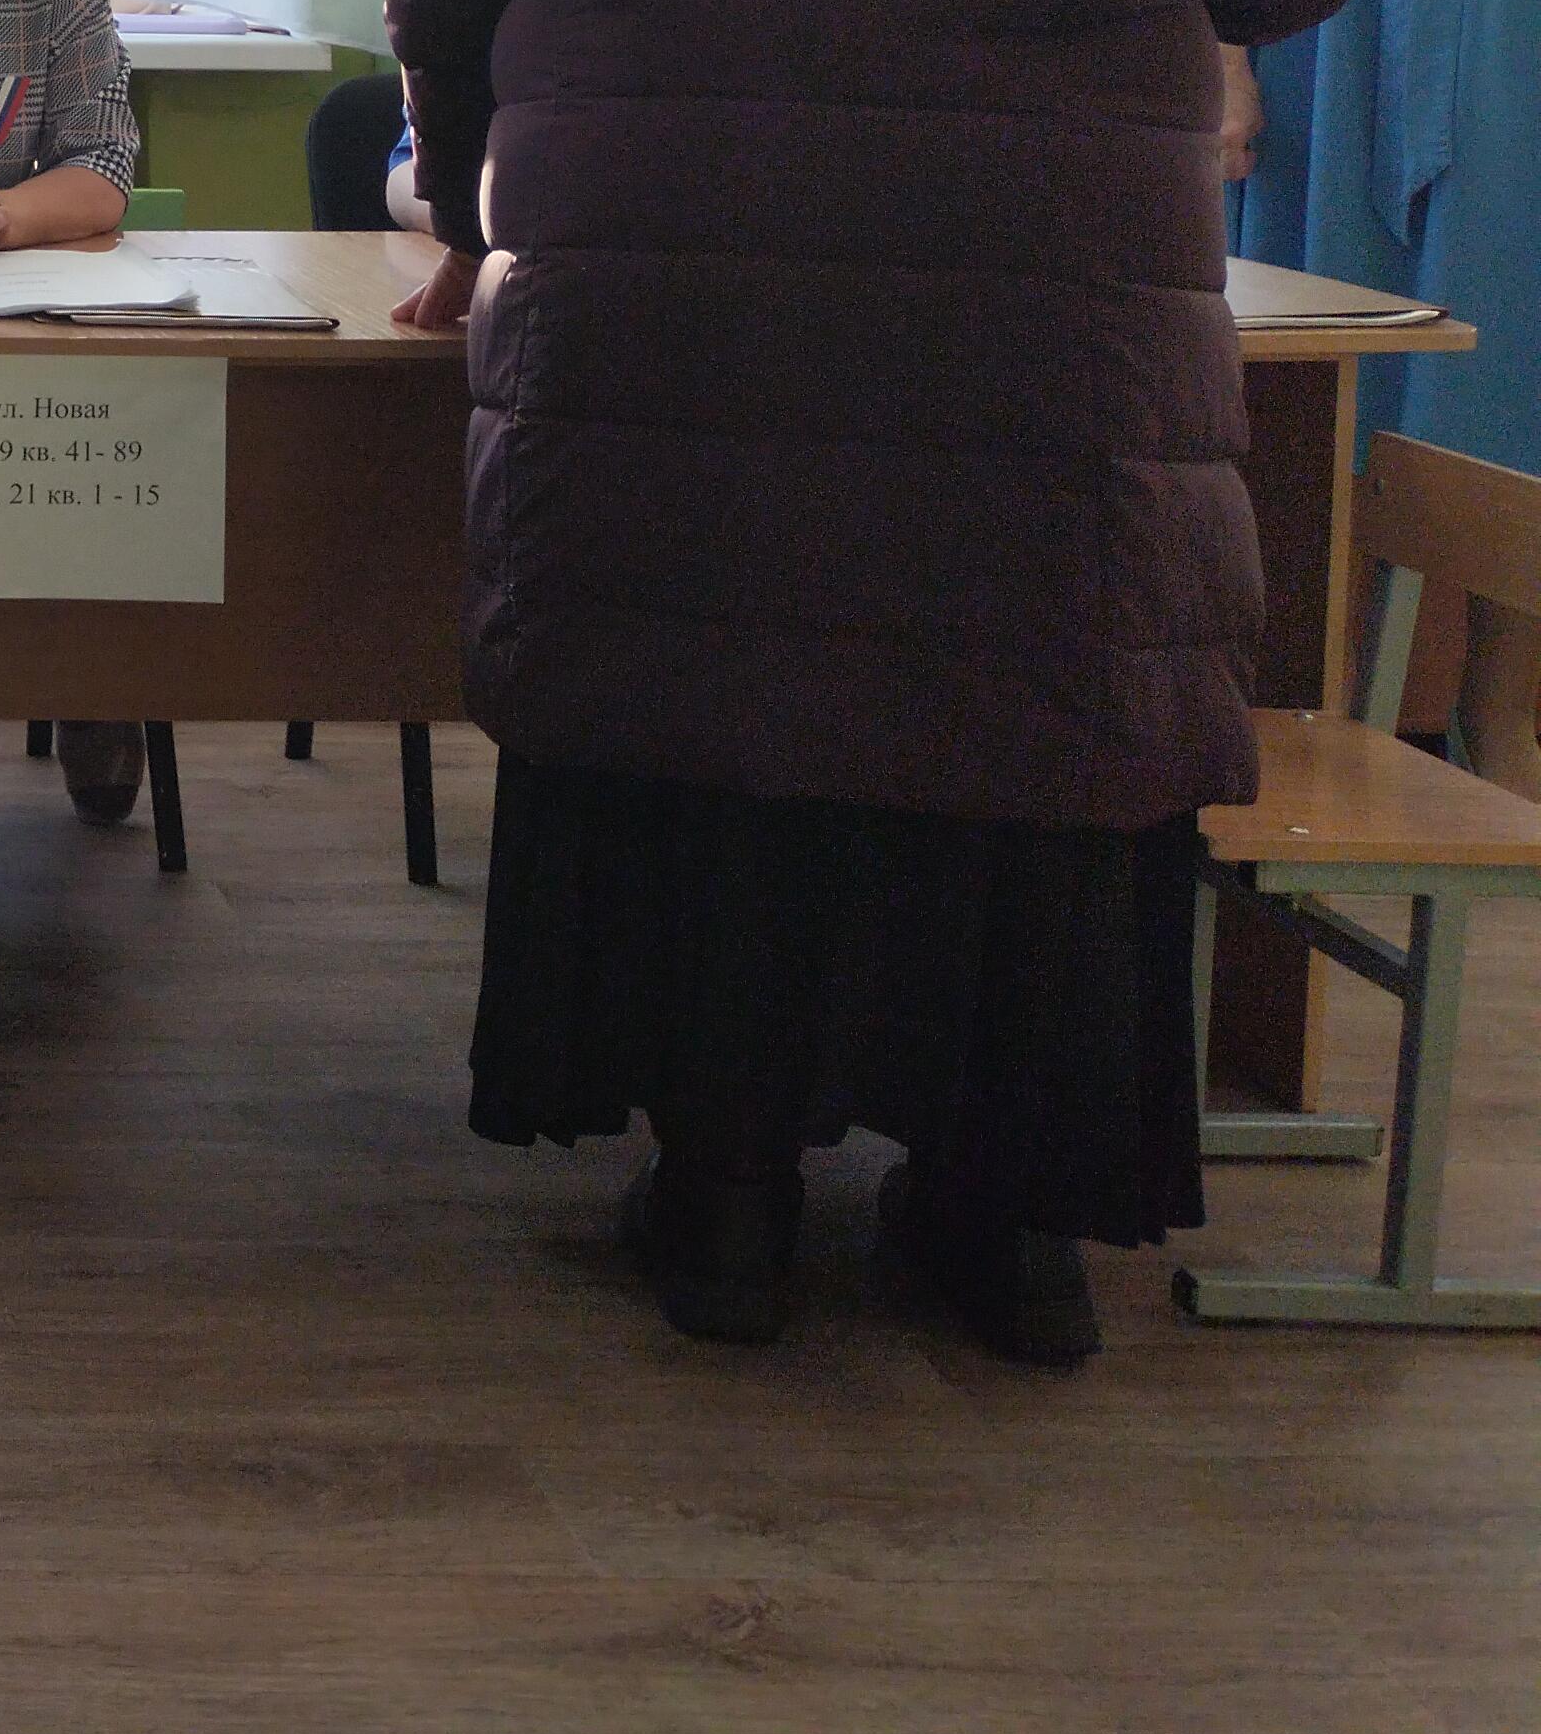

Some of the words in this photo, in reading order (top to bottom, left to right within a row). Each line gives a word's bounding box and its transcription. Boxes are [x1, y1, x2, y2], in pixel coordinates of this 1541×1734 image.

[33, 397, 110, 420] Новая
[21, 446, 56, 463] кв.
[113, 440, 143, 463] 89
[9, 482, 35, 505] 21
[47, 489, 82, 506] кв.
[135, 484, 160, 506] 15
